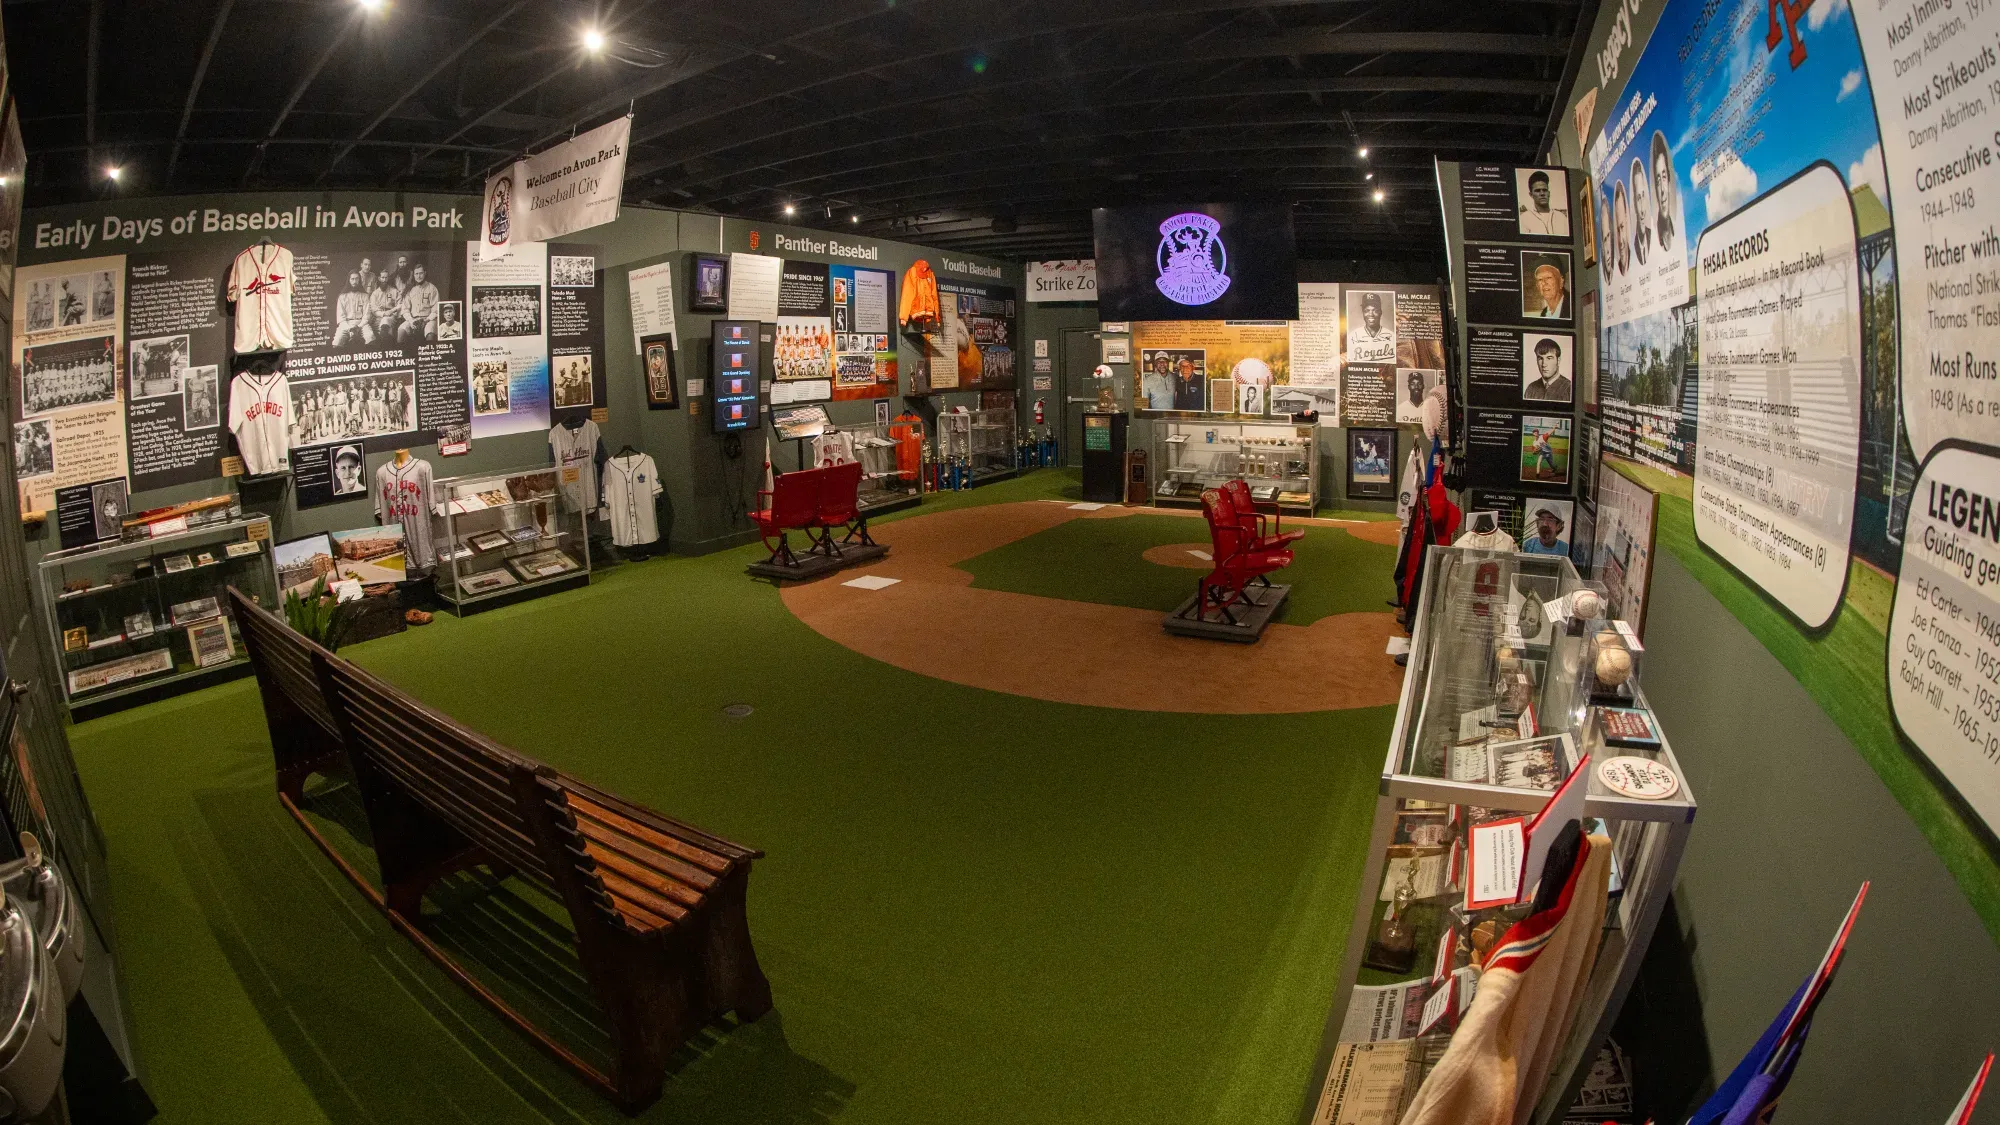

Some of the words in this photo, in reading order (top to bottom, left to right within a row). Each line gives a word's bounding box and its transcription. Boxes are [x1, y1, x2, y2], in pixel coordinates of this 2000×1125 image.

[1597, 1, 1632, 90] Legacy
[1886, 12, 1914, 50] Most
[1893, 48, 1922, 78] Danny
[1923, 16, 1966, 57] Albritton,
[1903, 85, 1932, 120] Most
[1932, 45, 1996, 100] Strikeouts
[1908, 124, 1938, 150] Danny
[1941, 98, 1987, 133] Albritton,
[526, 171, 562, 189] Welcome
[563, 166, 572, 175] to
[573, 156, 596, 172] Avon
[598, 144, 621, 163] Park
[1916, 144, 1991, 192] Consecutive
[530, 184, 575, 212] Baseball
[578, 177, 600, 195] City
[35, 219, 96, 249] Early
[102, 215, 163, 244] Days
[170, 210, 198, 234] of
[203, 206, 307, 233] Baseball
[315, 205, 336, 228] in
[342, 206, 404, 228] Avon
[412, 206, 463, 229] Park
[1191, 215, 1215, 230] PARK
[775, 234, 827, 254] Panther
[829, 240, 878, 260] Baseball
[1703, 249, 1728, 276] FHSAA
[1728, 228, 1769, 266] RECORDS
[1924, 238, 1966, 269] Pitcher
[1970, 225, 2000, 260] with
[942, 258, 968, 273] Youth
[969, 262, 1002, 278] Baseball
[1036, 276, 1074, 292] Strike
[1076, 276, 1096, 290] Zo
[1043, 264, 1054, 272] The
[1704, 287, 1716, 299] Avon
[1715, 283, 1725, 296] Park
[1726, 276, 1737, 296] High
[1738, 269, 1756, 290] School
[1762, 268, 1769, 283] In
[1769, 263, 1779, 280] the
[1780, 253, 1804, 277] Record
[1805, 245, 1826, 270] Book
[1927, 274, 1973, 303] (National
[1706, 312, 1716, 324] Most
[1716, 310, 1728, 323] State
[1728, 304, 1758, 321] Tournament
[1758, 299, 1779, 315] Games
[1779, 289, 1803, 315] Played
[1928, 309, 1968, 330] Thomas
[285, 357, 312, 368] HOUSE
[314, 356, 325, 365] OF
[327, 354, 351, 364] DAVID
[353, 351, 383, 361] BRINGS
[385, 350, 403, 358] 1932
[285, 367, 315, 378] SPRING
[317, 364, 356, 375] TRAINING
[357, 362, 369, 370] TO
[370, 359, 394, 369] AVON
[395, 358, 416, 367] PARK
[1354, 344, 1395, 361] Royals
[1706, 352, 1717, 364] Most
[1717, 351, 1728, 364] State
[1729, 350, 1758, 364] Tournament
[1759, 348, 1780, 364] Games
[1781, 346, 1797, 363] Won
[1929, 351, 1961, 378] Most
[1966, 351, 1997, 380] Runs
[1706, 394, 1716, 406] Most
[1716, 393, 1728, 407] State
[1729, 394, 1758, 412] Tournament
[1759, 397, 1800, 418] Appearances
[1930, 388, 1954, 411] 1948
[1957, 392, 1973, 418] (As
[1977, 400, 1984, 416] a
[823, 444, 842, 454] WHITE
[1703, 446, 1714, 460] Team
[1714, 450, 1726, 466] State
[1727, 454, 1764, 482] Championships
[1766, 466, 1774, 487] (8)
[1700, 486, 1725, 510] Consecutive
[1725, 498, 1738, 517] State
[1738, 504, 1769, 534] Tournament
[1769, 523, 1813, 561] Appearances
[1814, 544, 1827, 573] (8)
[1928, 480, 2000, 544] LEGEN
[1924, 525, 1974, 579] Guiding
[1916, 577, 1929, 600] Ed
[1930, 586, 1962, 621] Carter
[1911, 606, 1927, 631] Joe
[1928, 617, 1961, 656] Franza
[1900, 659, 1925, 695] Ralph
[1925, 681, 1944, 711] Hill
[1906, 633, 1926, 666] Guy
[1926, 649, 1962, 691] Garrett
[1973, 684, 2000, 723] 1953
[1622, 763, 1644, 790] CHAMPIONS
[1637, 769, 1652, 784] STATE
[1372, 1008, 1385, 1026] perfect
[1346, 1044, 1358, 1068] WALKER
[1337, 1069, 1351, 1102] MEMORIAL
